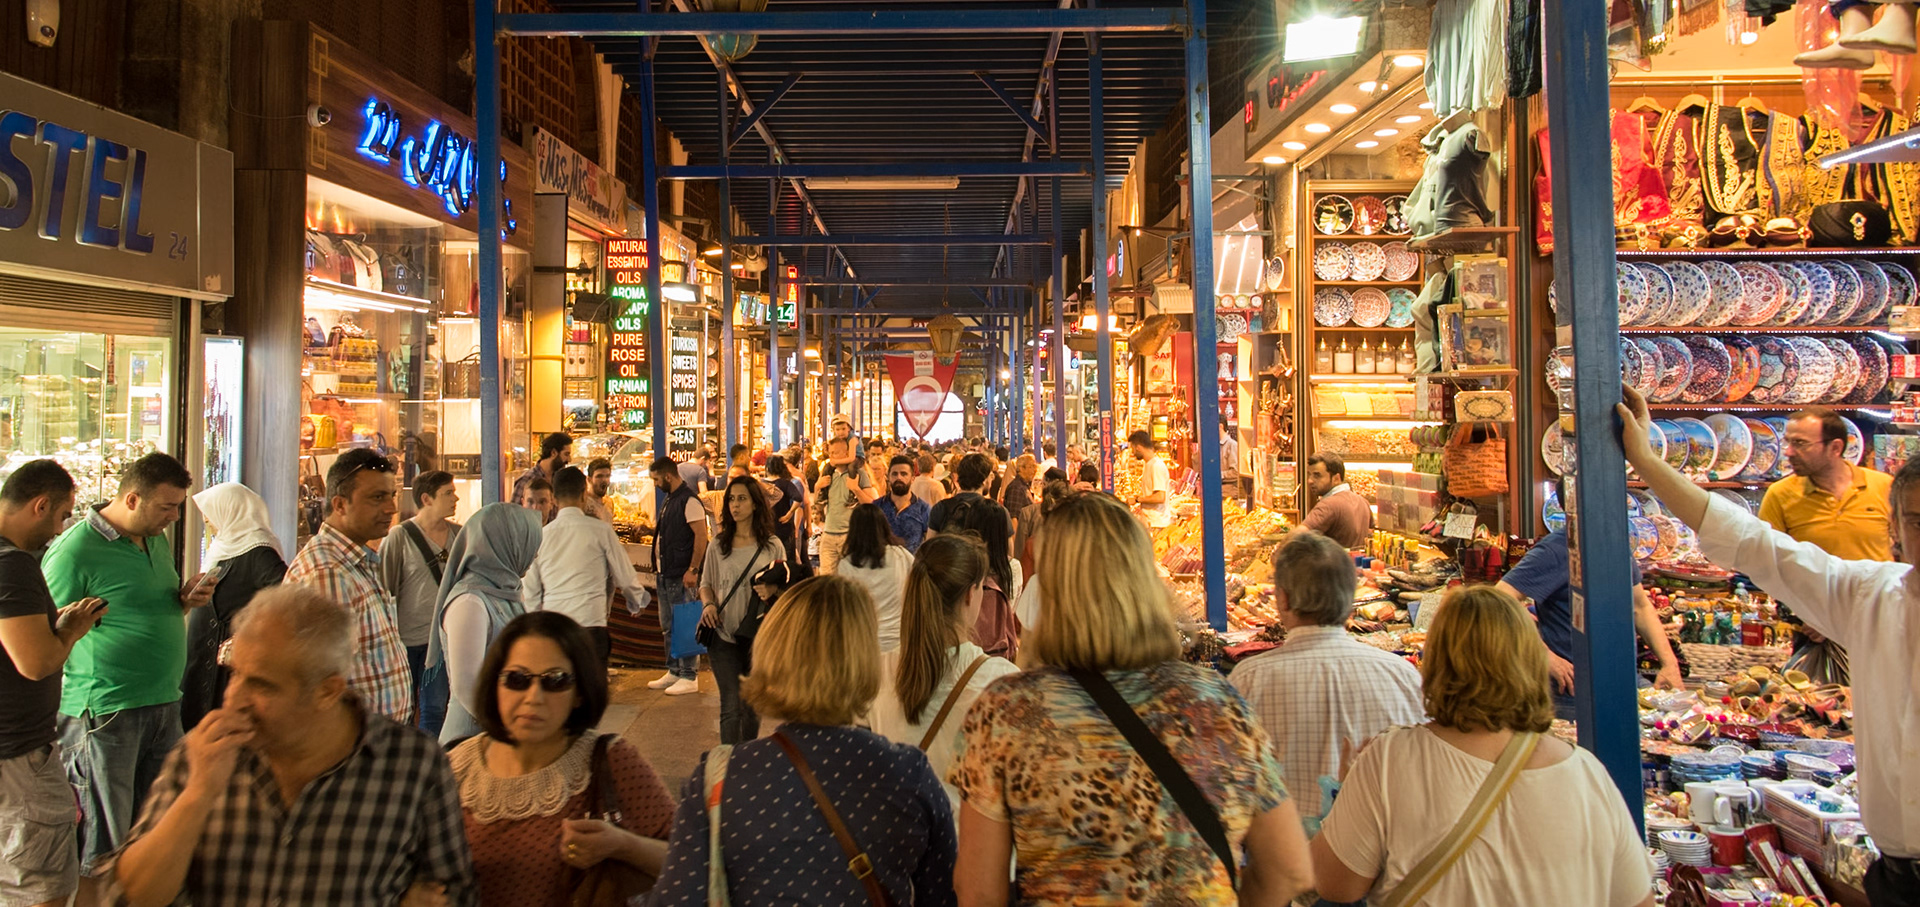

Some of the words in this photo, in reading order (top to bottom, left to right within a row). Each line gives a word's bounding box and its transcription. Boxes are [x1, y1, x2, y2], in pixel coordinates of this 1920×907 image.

[0, 110, 155, 256] STEL
[168, 232, 189, 261] 24
[608, 240, 648, 254] NATURAL
[616, 271, 642, 284] OILS
[612, 286, 646, 300] AROMA
[615, 317, 642, 331] OILS
[613, 333, 643, 346] PURE
[672, 336, 698, 352] TURKISH
[611, 348, 646, 361] ROSE
[672, 354, 698, 370] SWEETS
[620, 364, 639, 377] OIL
[608, 379, 648, 393] IRANIAN
[672, 373, 697, 389] SPICES
[674, 391, 695, 407] NUTS
[670, 410, 698, 426] SAFFRON
[673, 429, 695, 445] TEAS
[1102, 417, 1113, 490] GÖZDE
